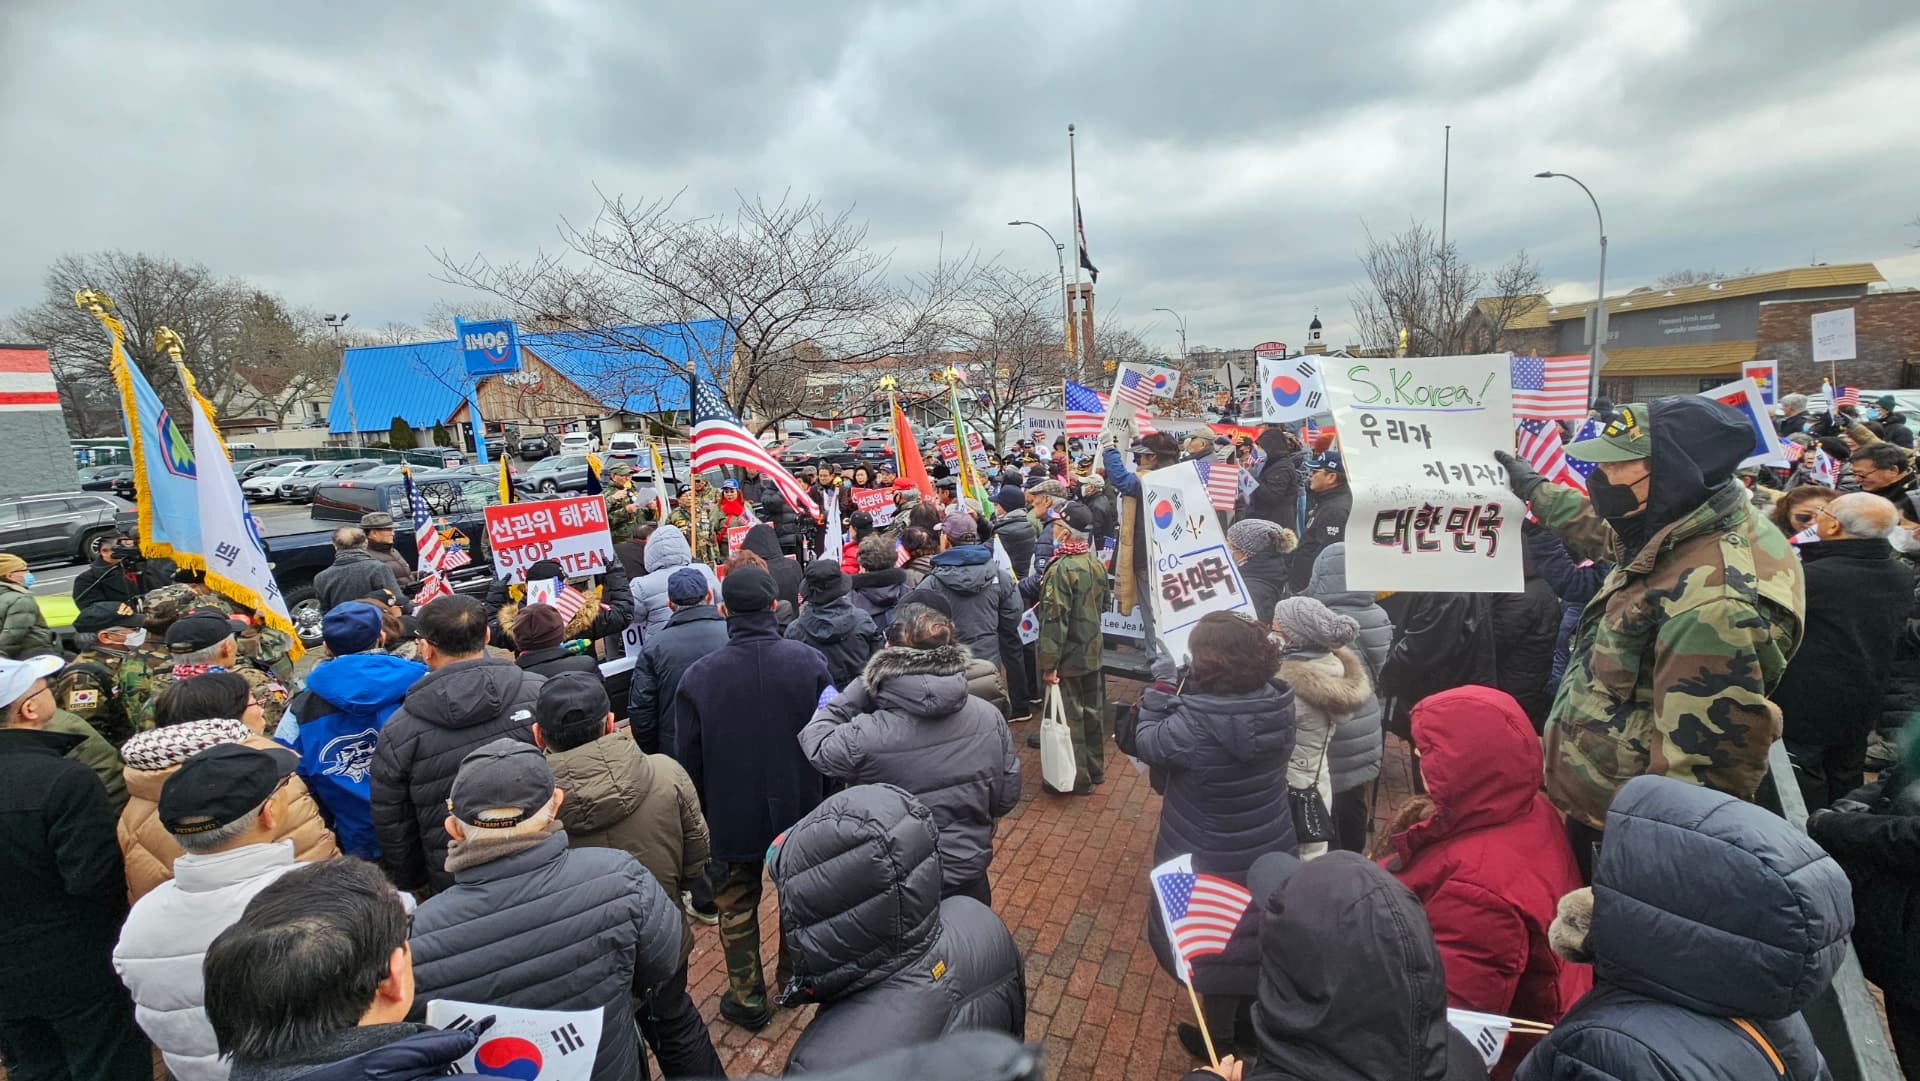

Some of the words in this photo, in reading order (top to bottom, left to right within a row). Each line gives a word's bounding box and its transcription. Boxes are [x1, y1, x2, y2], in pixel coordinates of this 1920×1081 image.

[1423, 460, 1505, 487] 지키자!
[491, 508, 556, 543] 선관위
[559, 499, 605, 527] 해체
[1372, 502, 1504, 558] 대한민국
[499, 541, 553, 567] STOP
[1104, 619, 1120, 628] Lee
